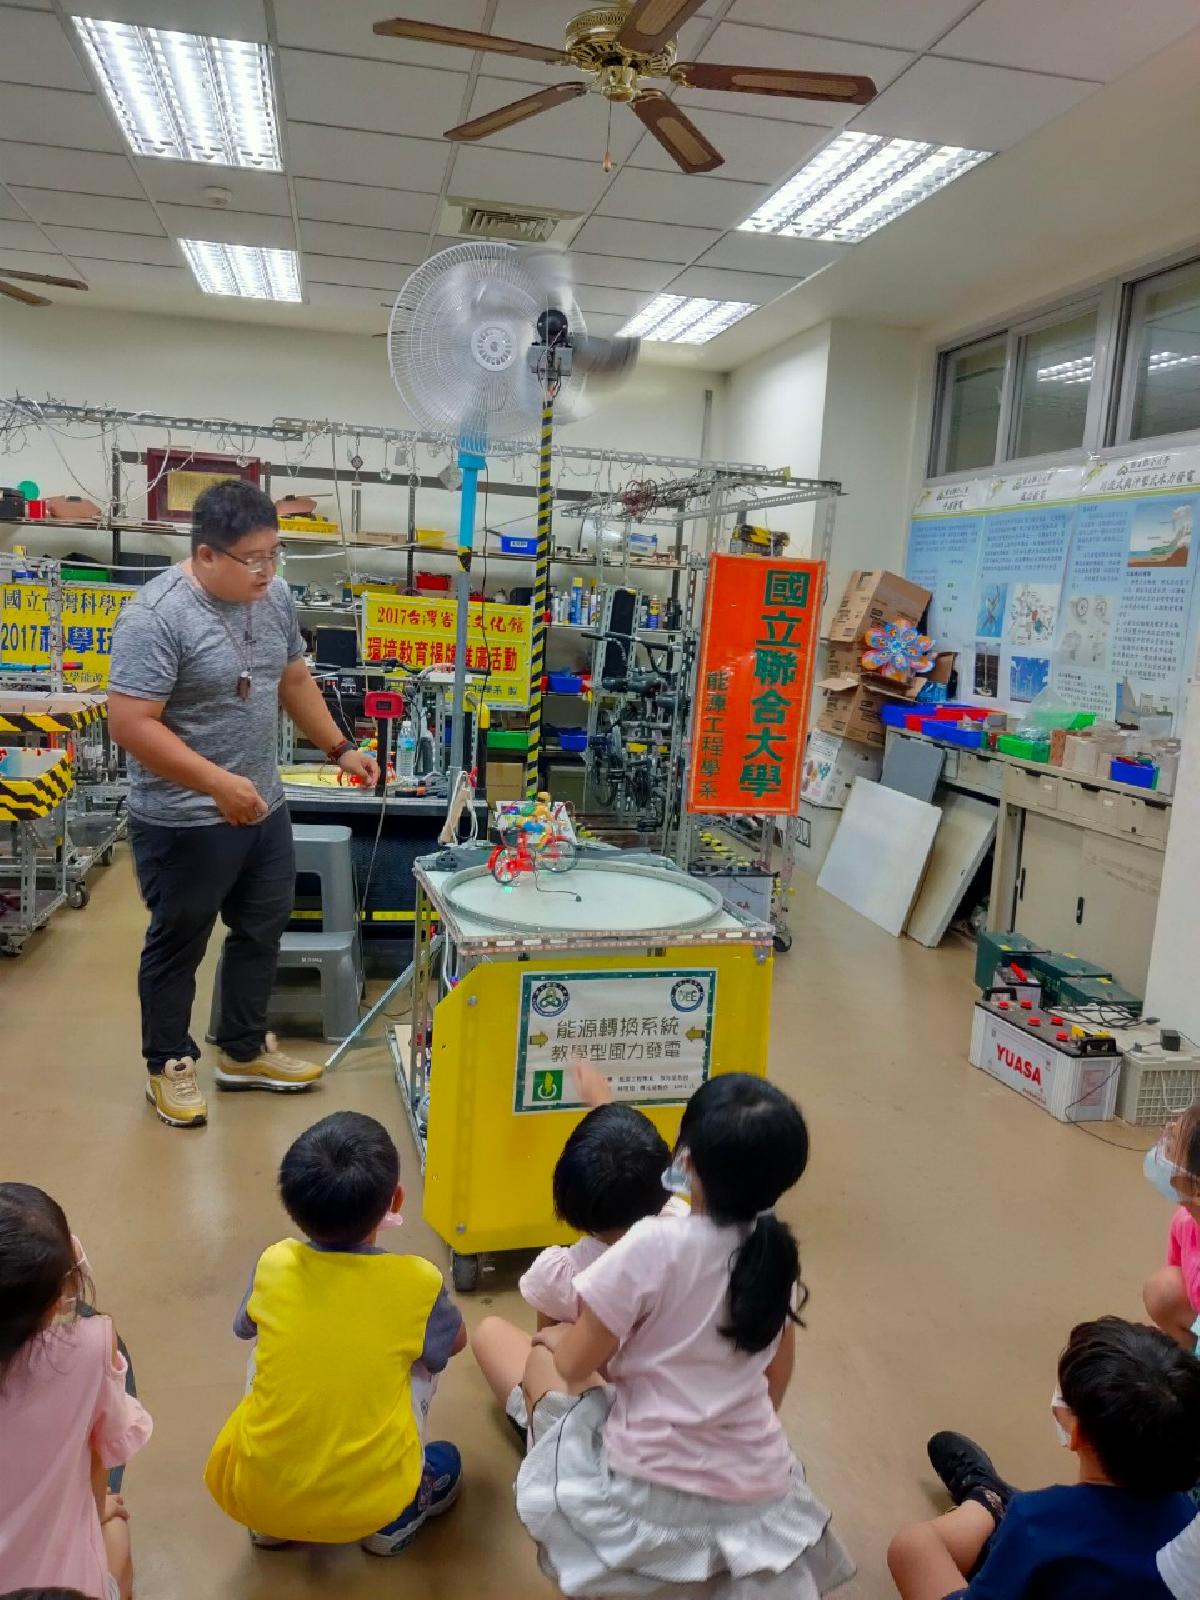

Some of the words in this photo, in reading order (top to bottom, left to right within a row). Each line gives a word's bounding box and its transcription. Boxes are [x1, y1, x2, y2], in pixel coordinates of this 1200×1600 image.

[377, 606, 524, 633] 2017台灣客文化館
[738, 569, 811, 798] 國立聯合大學
[699, 671, 729, 800] 能源工程學系
[556, 1016, 681, 1040] 能源轉換系統
[551, 1040, 682, 1063] 教學型風力發電
[996, 1043, 1042, 1086] YUASA
